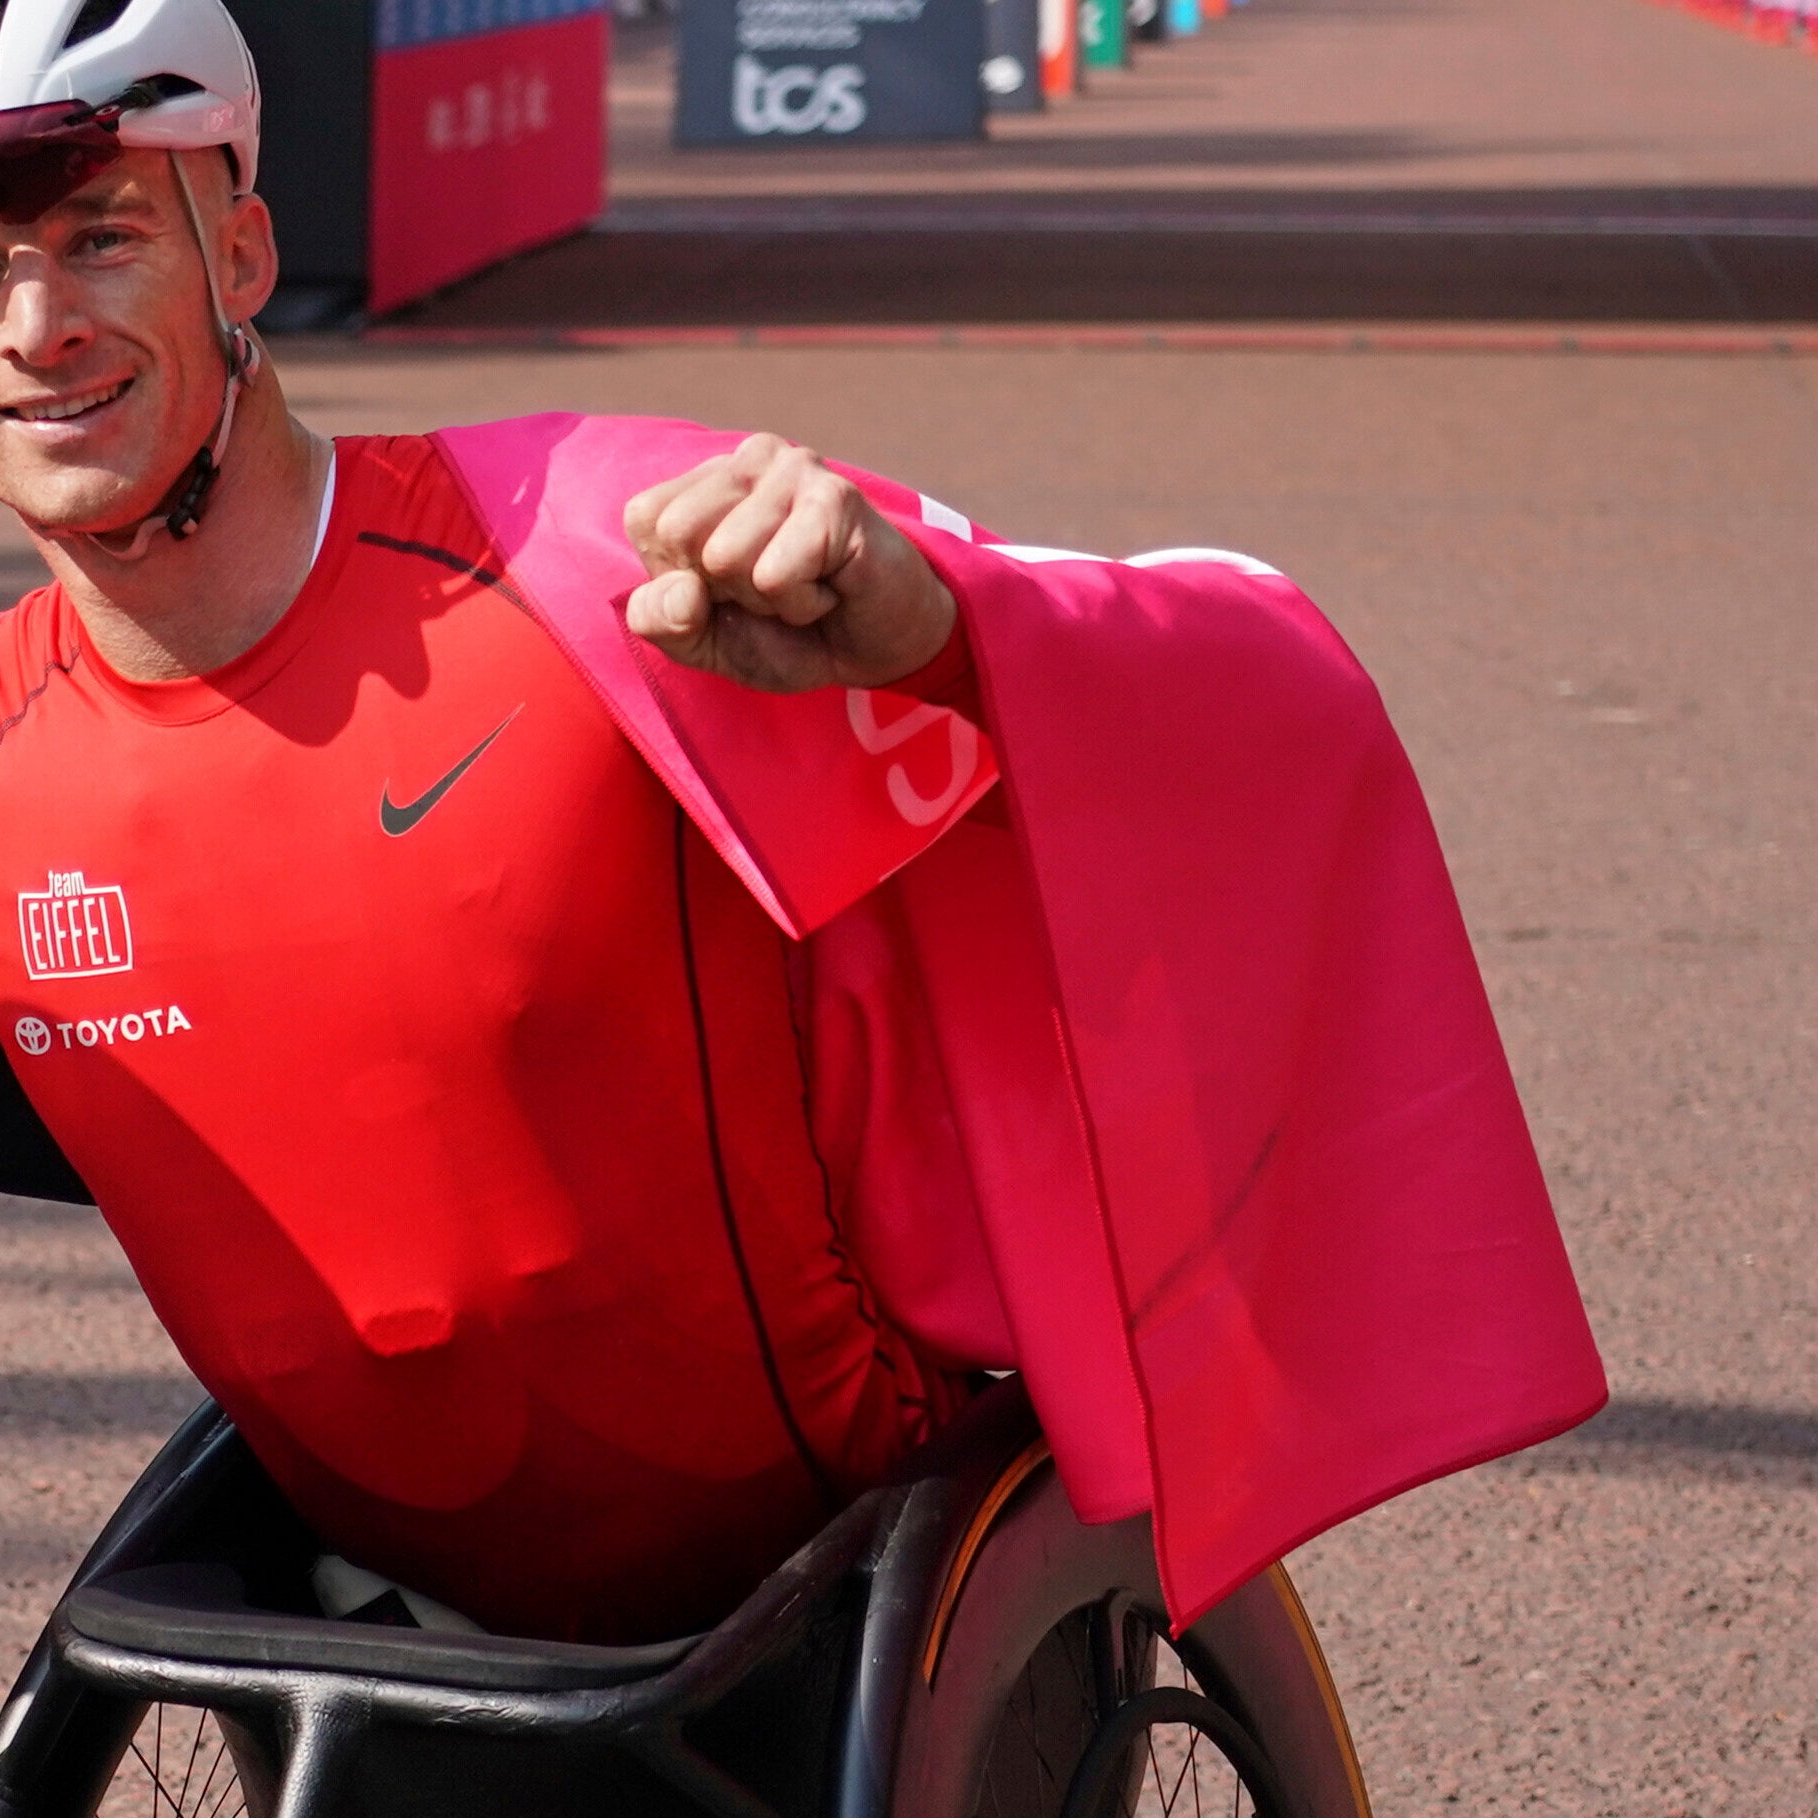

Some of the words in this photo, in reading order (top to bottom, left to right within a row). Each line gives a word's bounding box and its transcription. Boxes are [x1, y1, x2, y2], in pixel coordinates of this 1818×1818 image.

[732, 53, 864, 134] tcs
[47, 869, 85, 898] team
[27, 897, 122, 971] EIFFEL
[56, 1005, 192, 1049] TOYOTA
